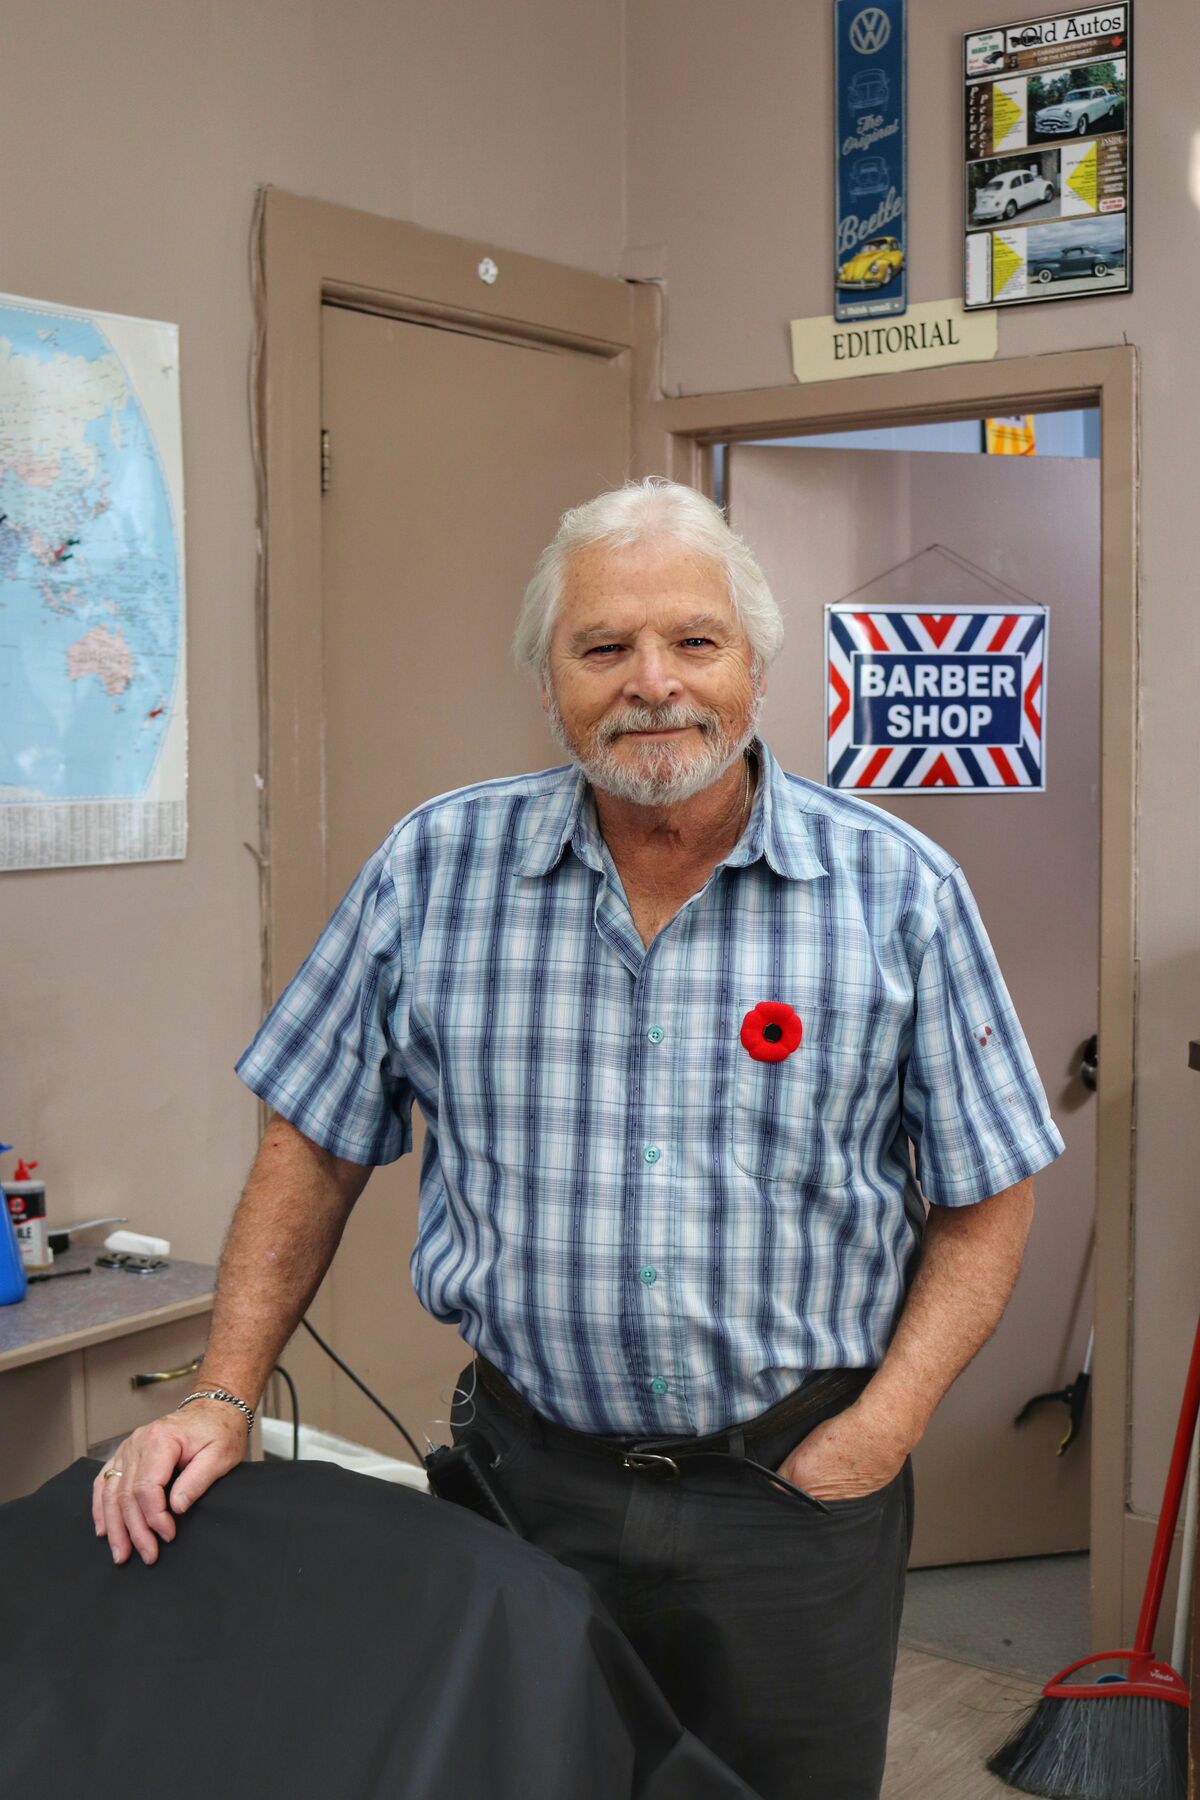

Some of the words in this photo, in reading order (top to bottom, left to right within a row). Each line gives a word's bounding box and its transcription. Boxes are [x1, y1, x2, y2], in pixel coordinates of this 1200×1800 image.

[1020, 22, 1057, 47] Old
[1063, 16, 1121, 40] Autos
[842, 119, 899, 156] Original
[856, 114, 884, 136] The
[837, 186, 904, 256] Beetle
[833, 319, 960, 360] EDITORIAL
[860, 664, 1017, 698] BARBER
[887, 704, 993, 738] SHOP
